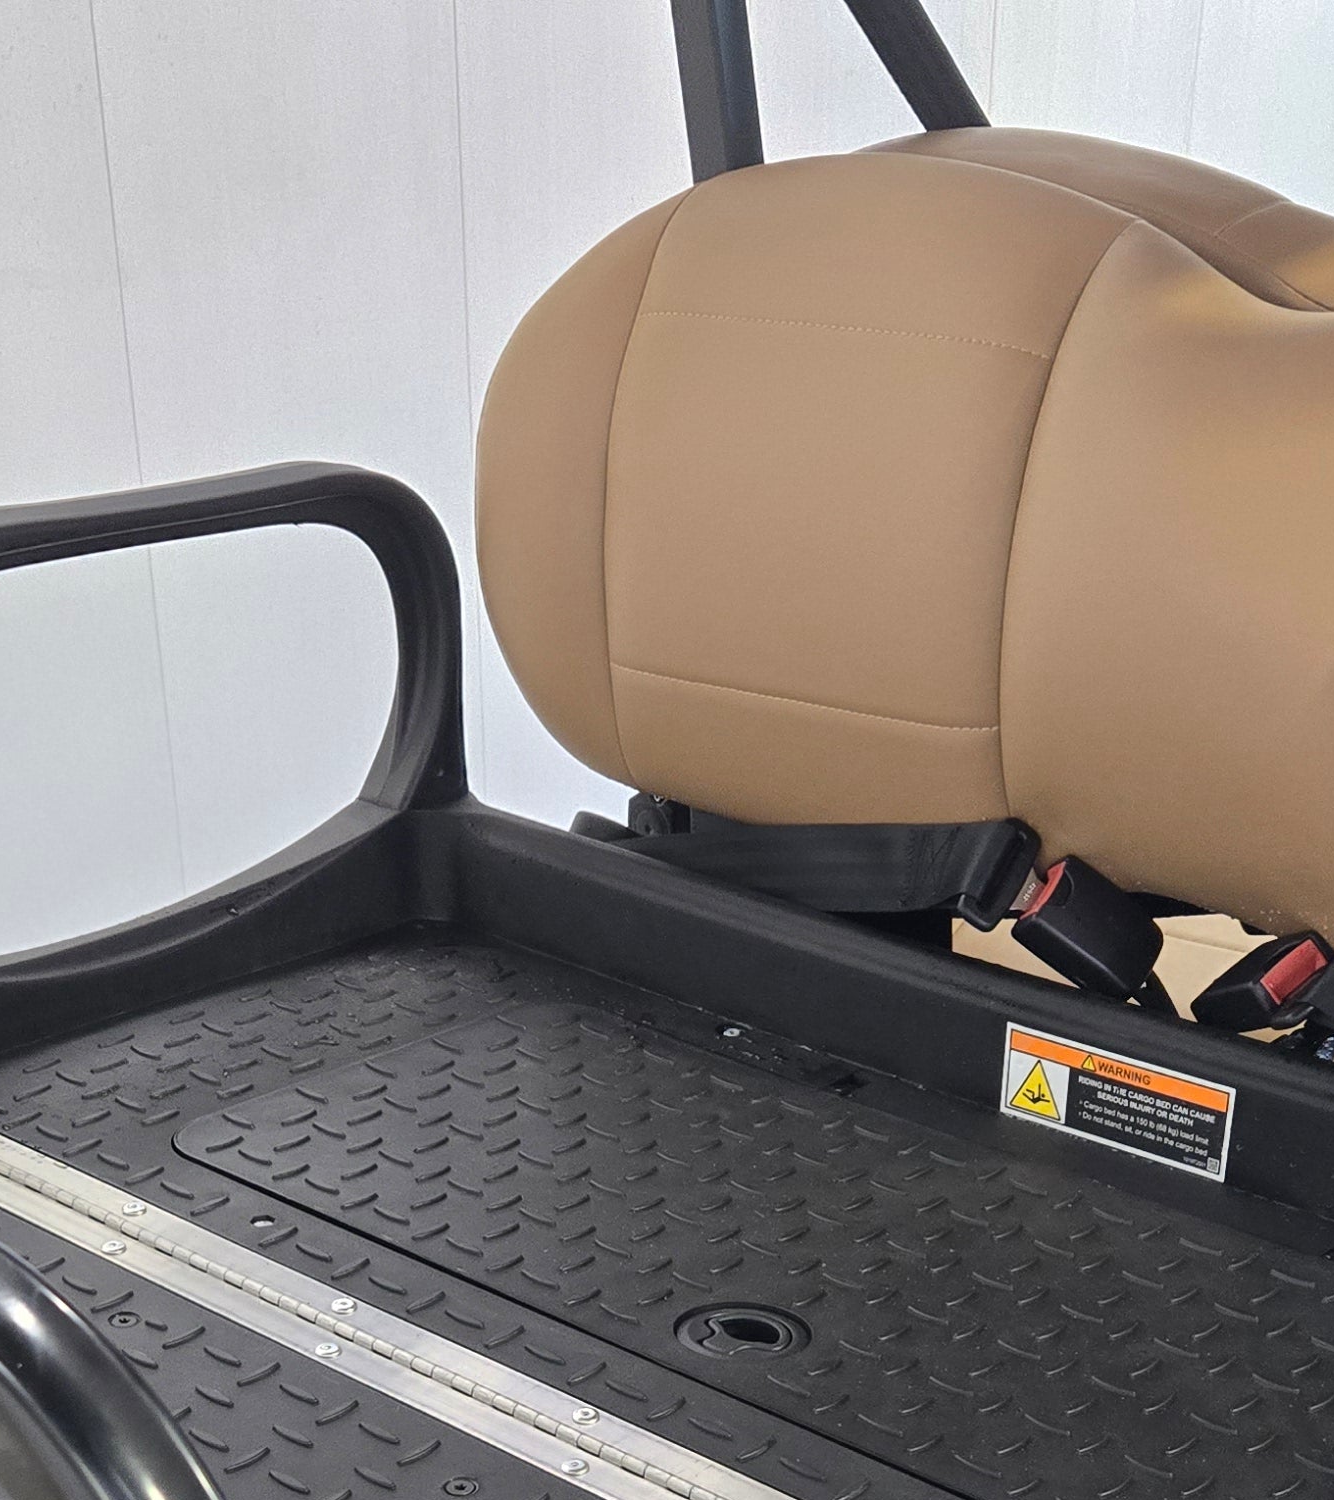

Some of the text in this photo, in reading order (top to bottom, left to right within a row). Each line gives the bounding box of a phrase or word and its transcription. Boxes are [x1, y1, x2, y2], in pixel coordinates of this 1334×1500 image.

[1098, 1061, 1151, 1085] WARNING
[1078, 1075, 1216, 1124] RIDING IN THE CARGO BED CAN CAUSE
[1097, 1091, 1194, 1127] SERIOUS INJURY OR DEATH
[1082, 1111, 1092, 1120] Do
[1093, 1116, 1104, 1124] not
[1143, 1131, 1155, 1140] ride
[1156, 1134, 1163, 1142] in
[1164, 1137, 1174, 1146] the
[1175, 1141, 1194, 1153] cargo
[1194, 1146, 1208, 1157] bed
[1083, 1100, 1103, 1113] Cargo
[1104, 1107, 1116, 1116] bed
[1117, 1111, 1128, 1121] has
[1149, 1121, 1155, 1129] lb
[1168, 1126, 1179, 1137] kg)
[1180, 1130, 1194, 1140] load
